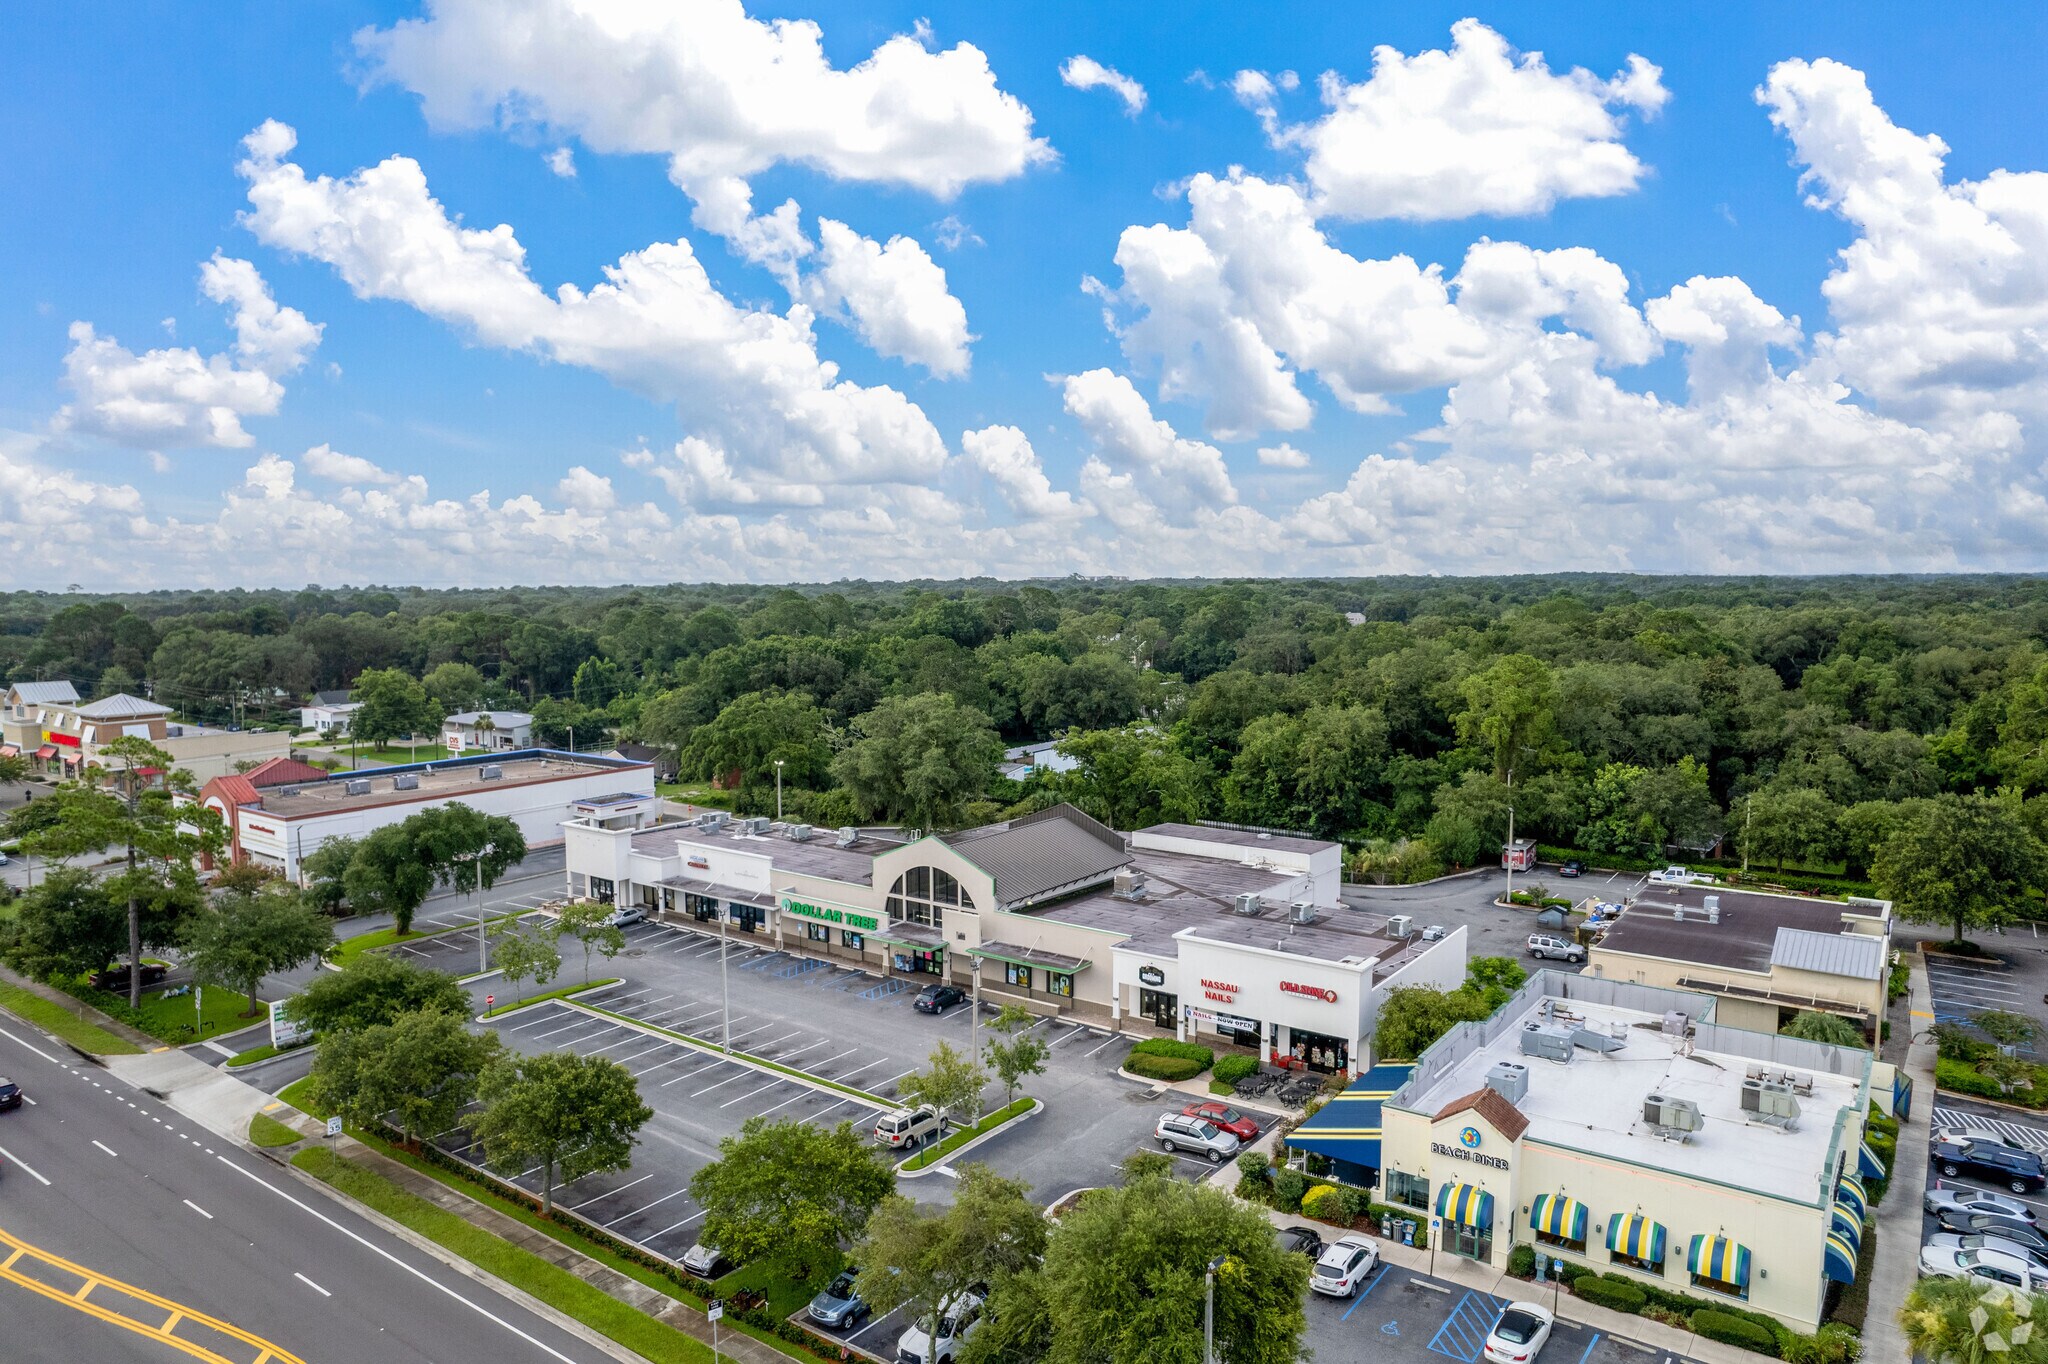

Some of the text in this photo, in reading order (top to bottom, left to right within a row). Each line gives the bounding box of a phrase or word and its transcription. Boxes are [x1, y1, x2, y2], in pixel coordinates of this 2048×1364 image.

[791, 901, 879, 931] DOLLAR TREE
[1200, 978, 1238, 993] NASSAU
[1279, 980, 1300, 993] COLD
[1205, 990, 1232, 1004] NAILS
[1192, 1010, 1212, 1020] NAILS
[1217, 1016, 1233, 1025] NOW
[1234, 1020, 1253, 1029] OPEN
[329, 1124, 341, 1133] 35
[1430, 1142, 1509, 1171] BEACH DINER
